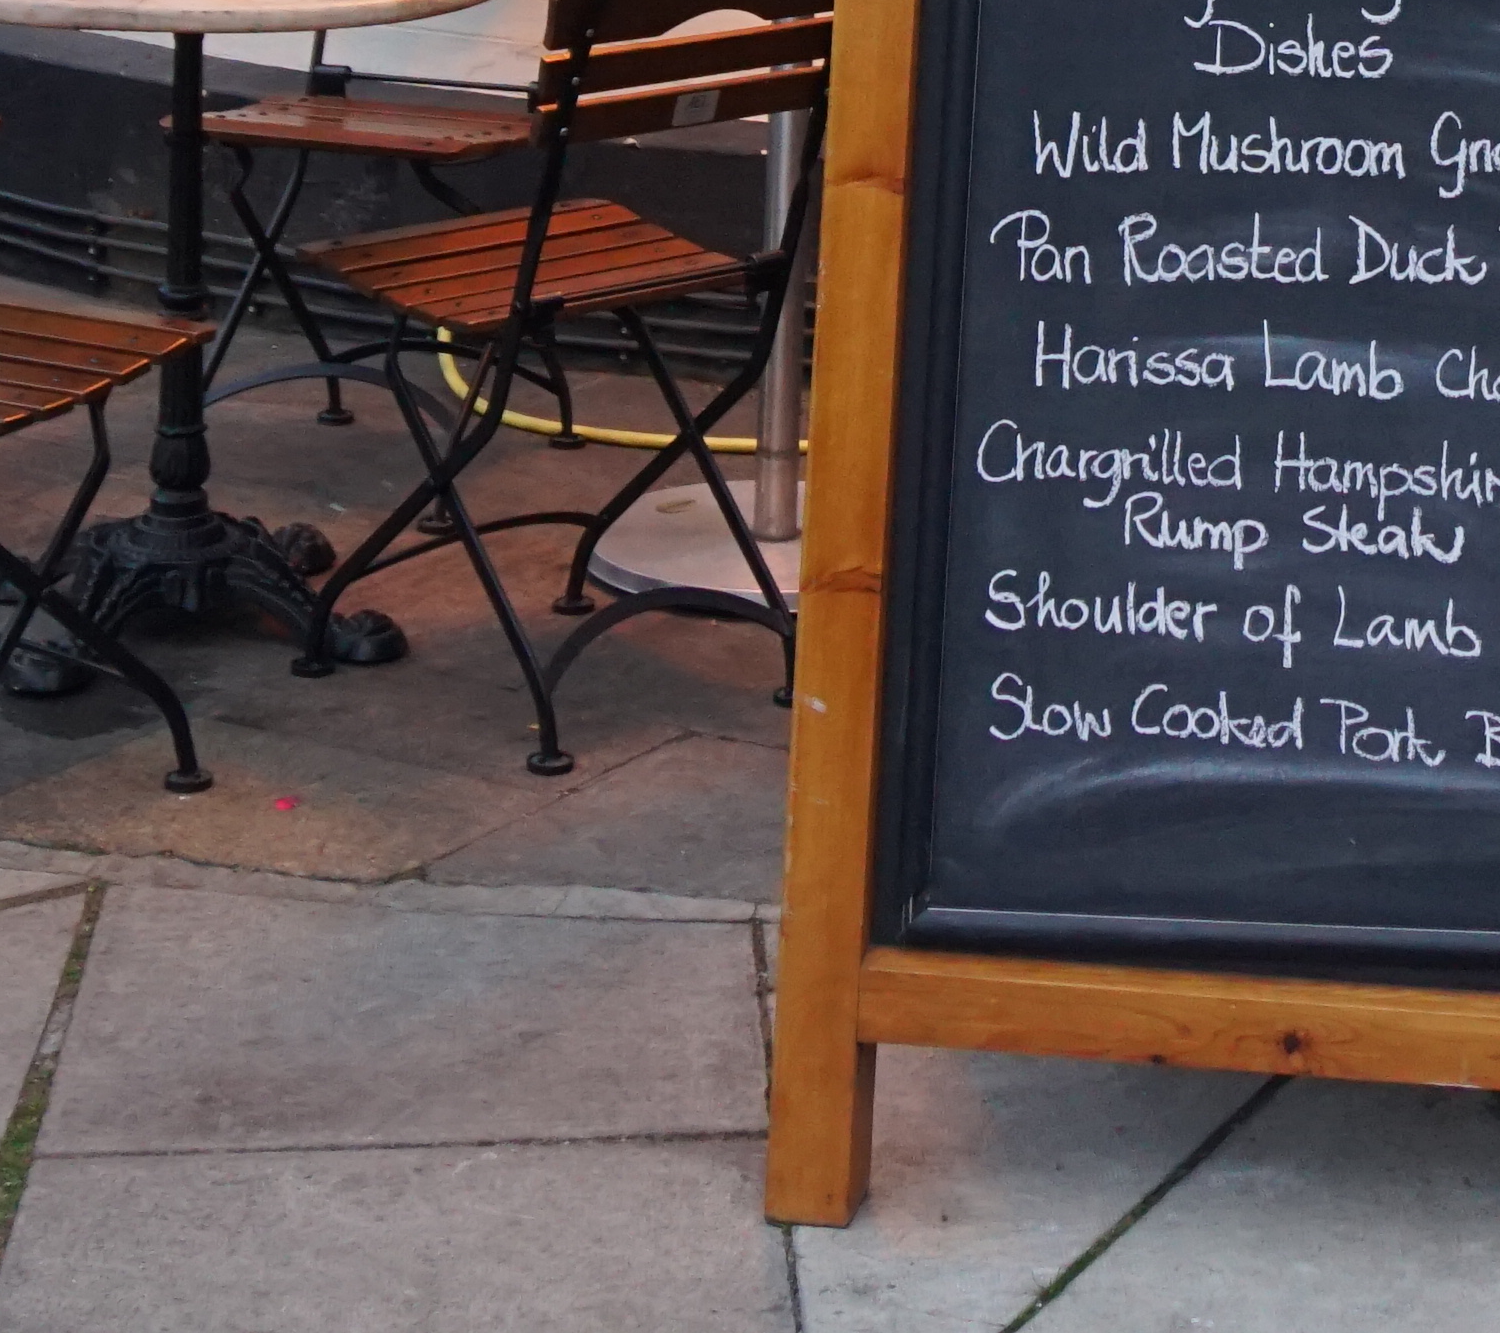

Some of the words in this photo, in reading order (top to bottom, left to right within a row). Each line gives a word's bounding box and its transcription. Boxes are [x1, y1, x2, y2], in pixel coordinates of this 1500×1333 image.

[1194, 13, 1393, 79] Dishes
[1033, 109, 1149, 179] Wild
[1173, 111, 1406, 180] Mushroom
[990, 209, 1091, 283] Pan
[1118, 212, 1328, 285] Roasted
[1348, 214, 1488, 286] Duck
[1034, 320, 1235, 390] Harissa
[1263, 319, 1406, 400] Lamb
[976, 419, 1242, 508] Chargrilled
[1122, 491, 1269, 570] Rump
[1301, 504, 1465, 565] Steak
[984, 569, 1217, 643] Shoulder
[1243, 585, 1302, 669] of
[1333, 586, 1482, 659] Lamb
[989, 672, 1112, 742] Slow
[1131, 683, 1304, 751] Cooked
[1319, 699, 1446, 767] Pork
